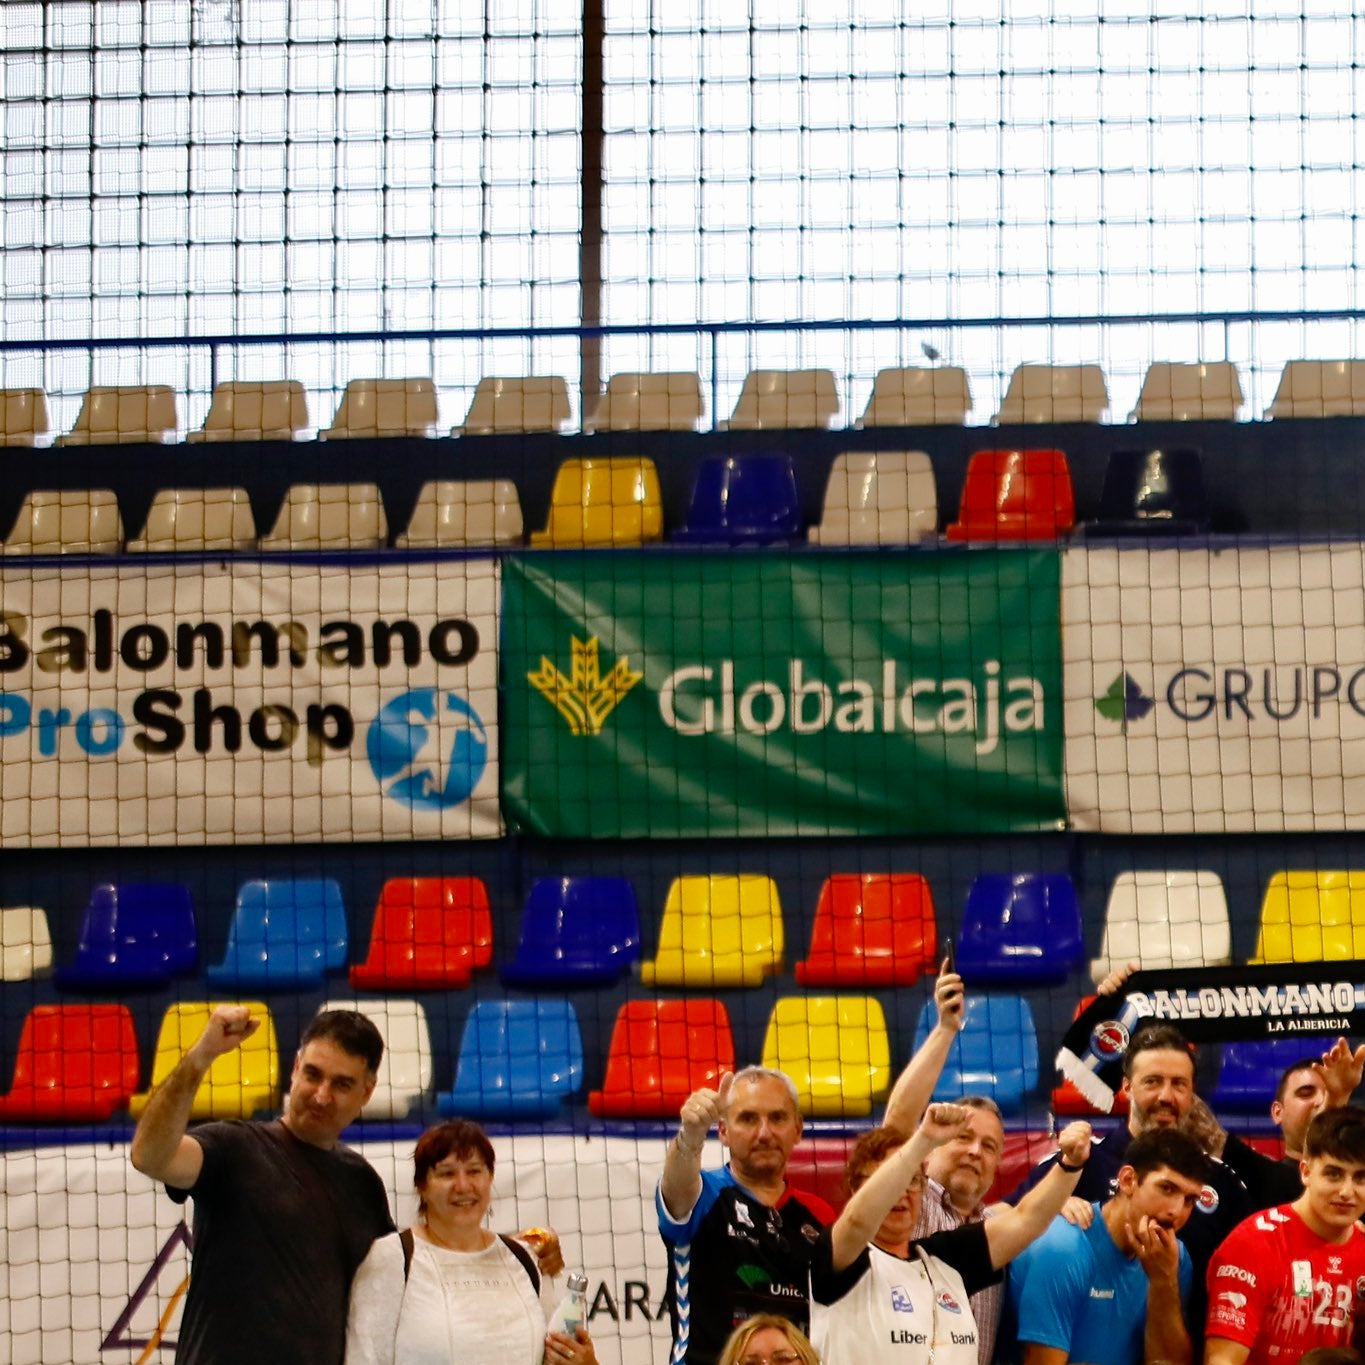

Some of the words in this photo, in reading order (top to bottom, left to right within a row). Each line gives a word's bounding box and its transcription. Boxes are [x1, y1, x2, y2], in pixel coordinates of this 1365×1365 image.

[658, 659, 1045, 755] Globalcaja
[1126, 981, 1357, 1020] BALONMANO
[1267, 1020, 1286, 1032] LA
[1286, 1018, 1351, 1031] ALBERICIA
[1312, 1280, 1353, 1328] 23
